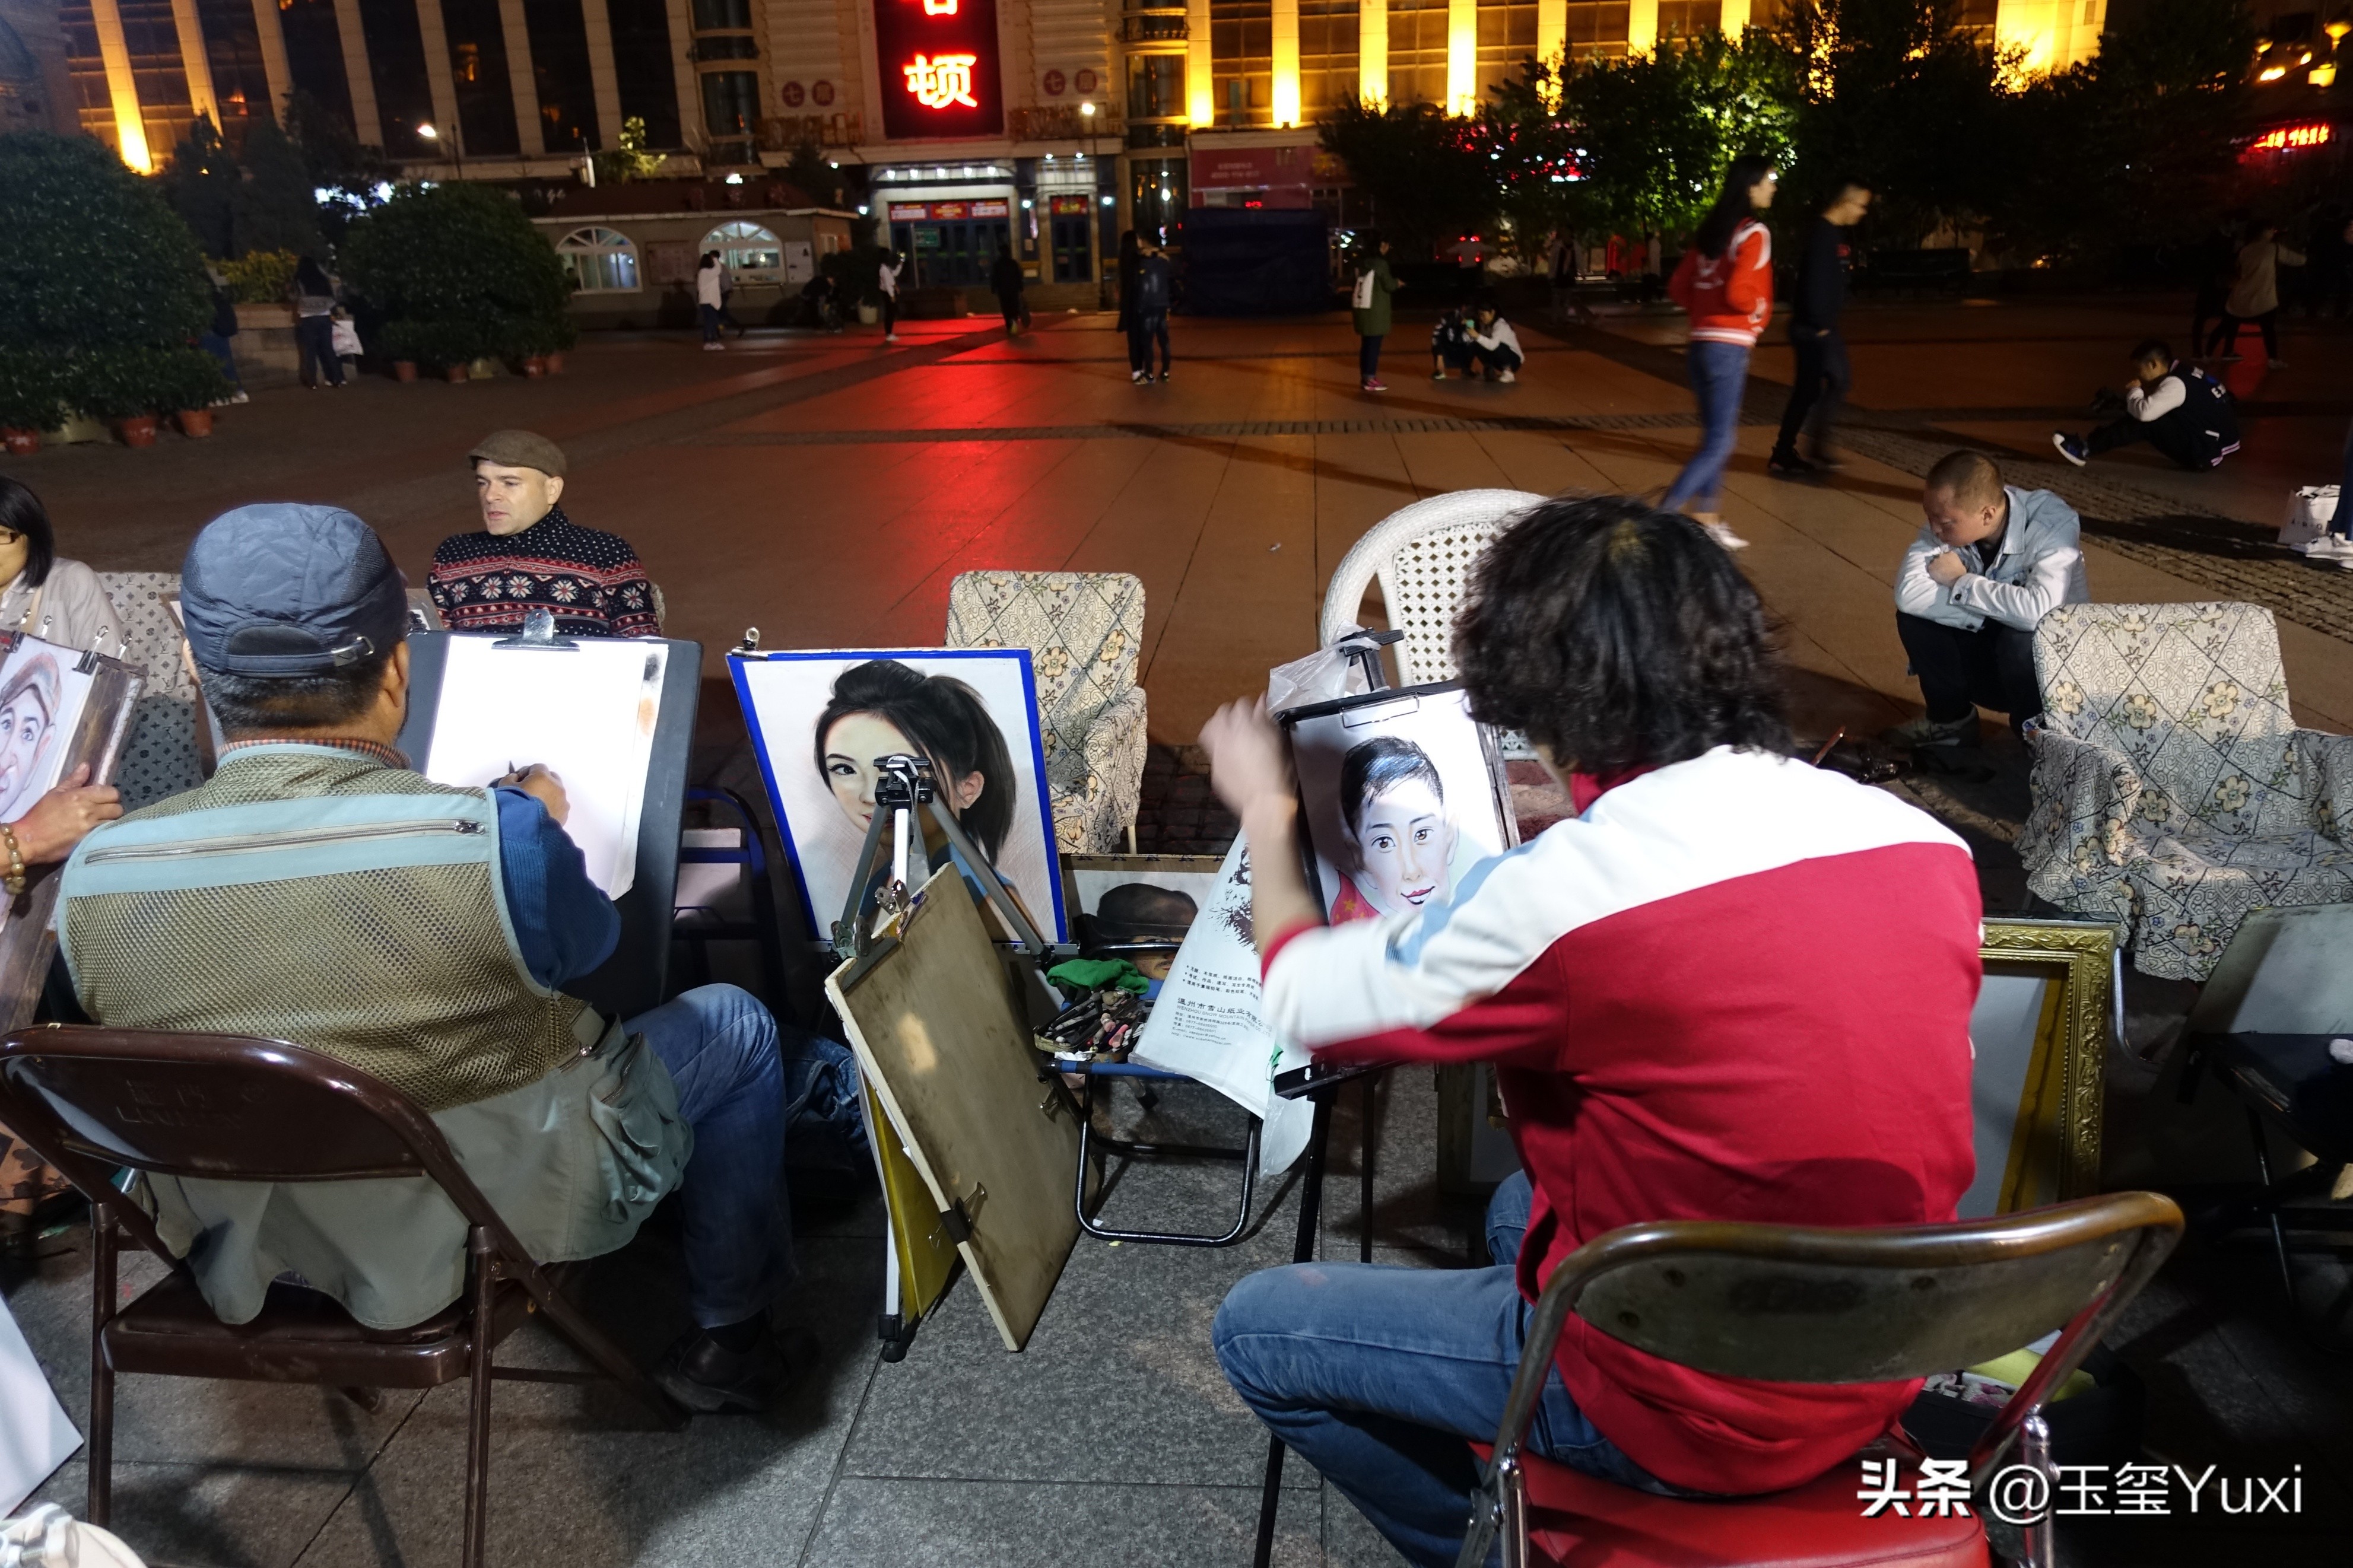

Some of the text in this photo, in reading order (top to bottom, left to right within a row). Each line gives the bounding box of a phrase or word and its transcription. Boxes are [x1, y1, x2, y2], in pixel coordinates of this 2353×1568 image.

[1177, 1005, 1202, 1014] WENZHOU
[1177, 997, 1272, 1032] 温州市雪山纸业有限公司
